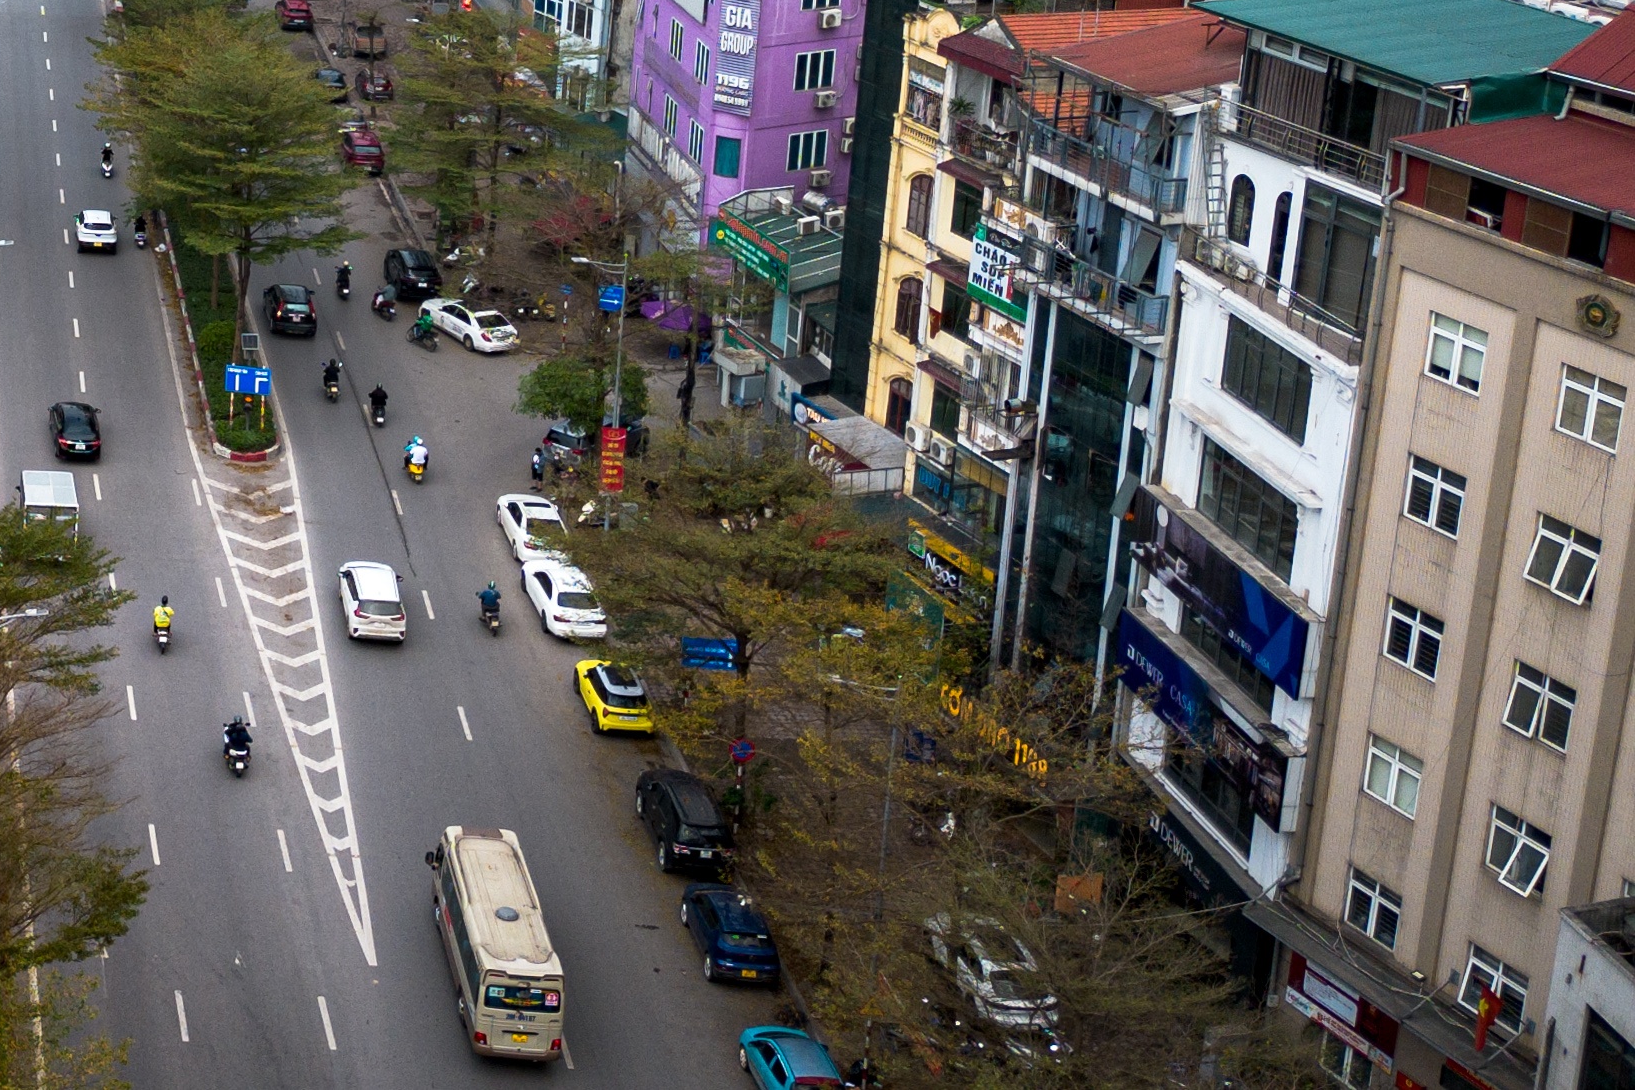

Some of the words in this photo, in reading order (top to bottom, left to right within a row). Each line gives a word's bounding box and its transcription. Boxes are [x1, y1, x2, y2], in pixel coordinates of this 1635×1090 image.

[726, 6, 753, 30] GIA
[720, 32, 754, 56] GROUP
[716, 73, 750, 90] 1196
[975, 242, 1007, 267] CHÁO
[1135, 650, 1164, 686] DEWER
[1169, 684, 1193, 717] CASA
[1161, 822, 1194, 872] DEWER
